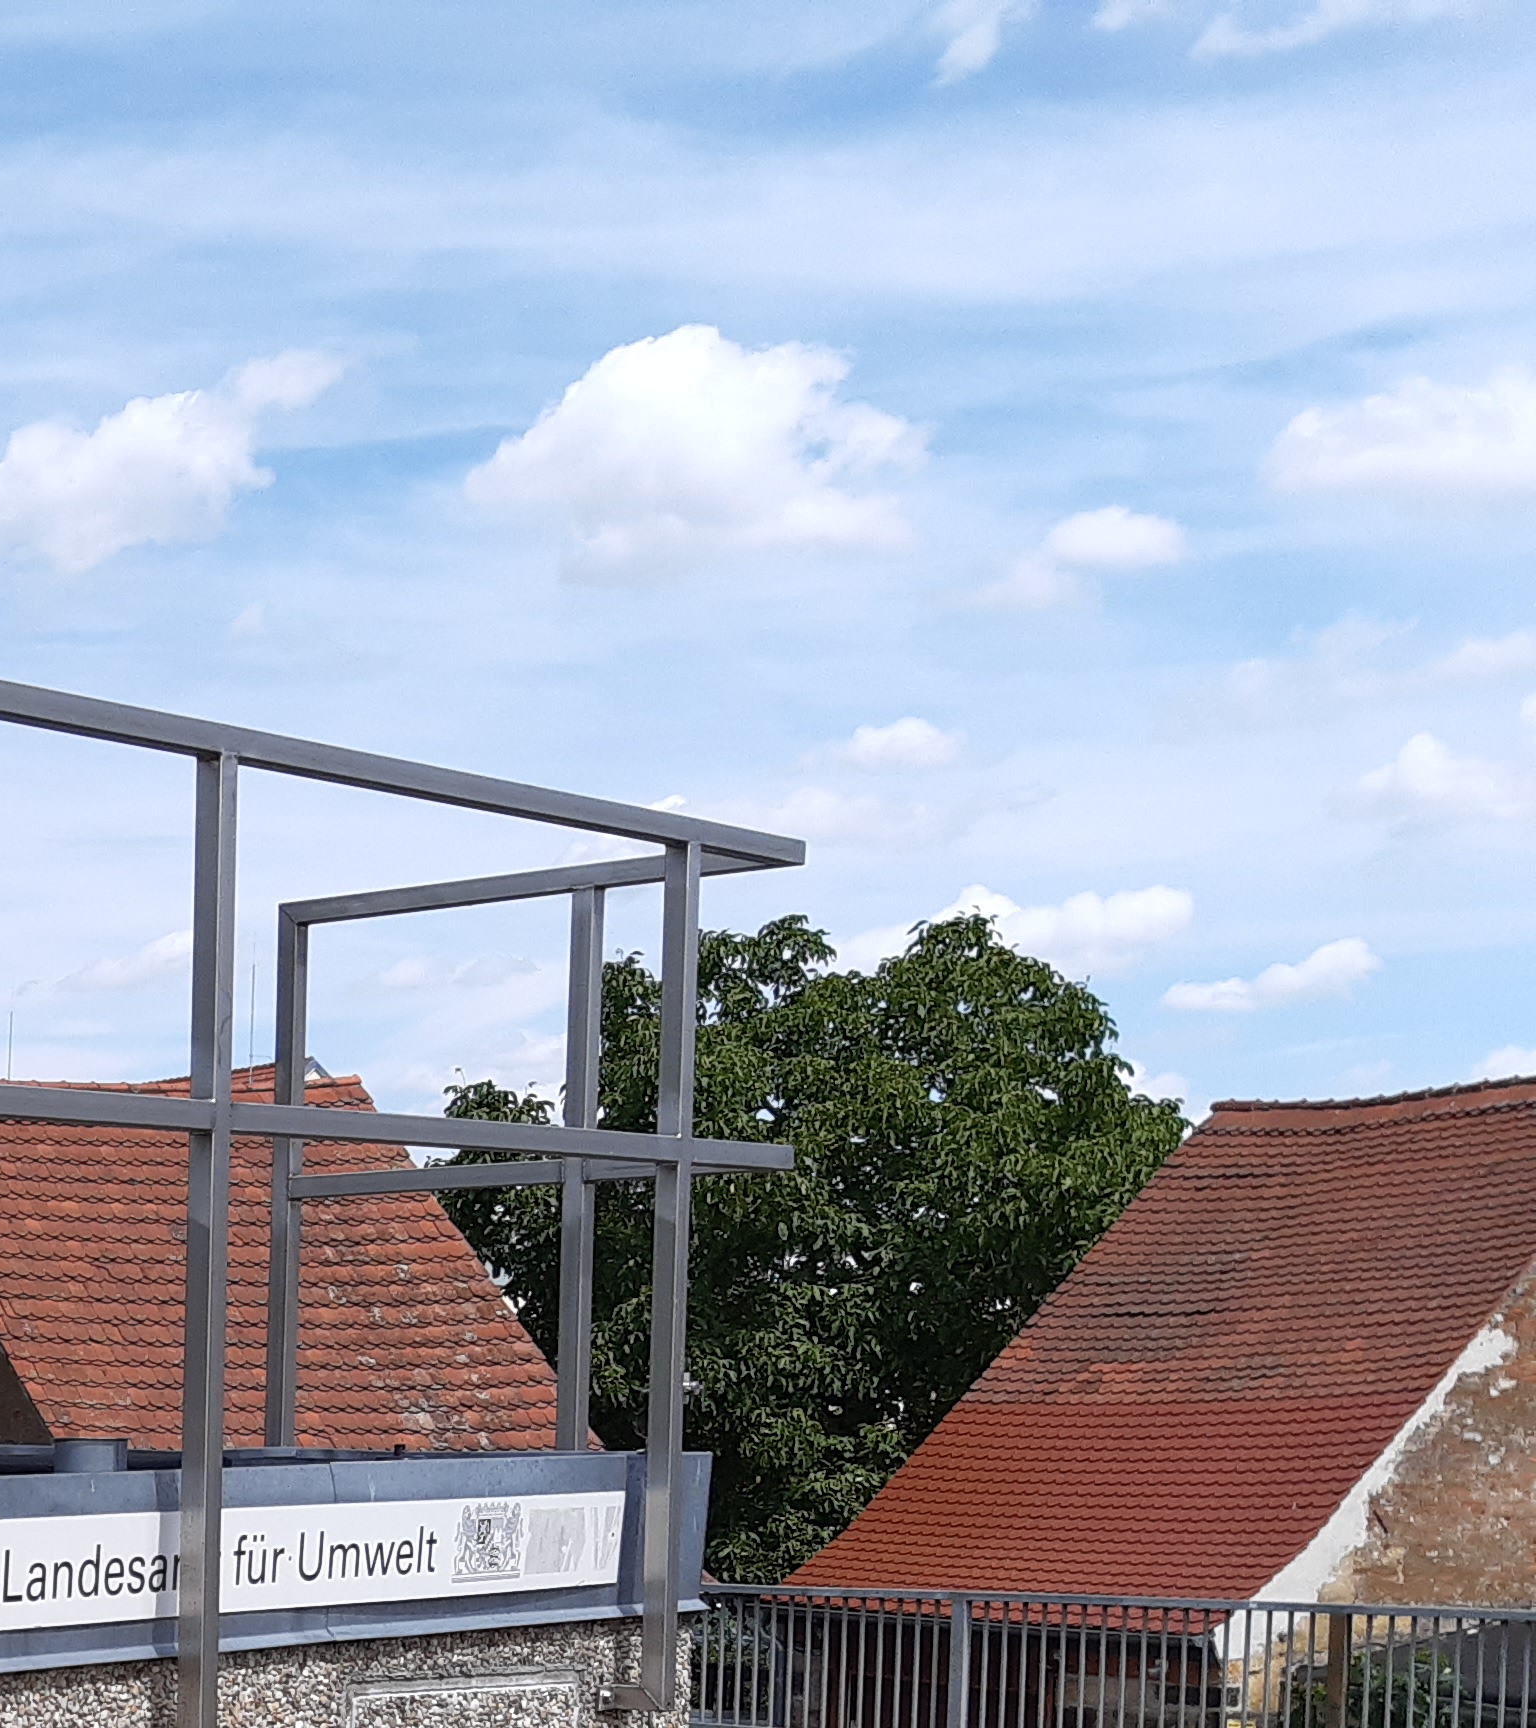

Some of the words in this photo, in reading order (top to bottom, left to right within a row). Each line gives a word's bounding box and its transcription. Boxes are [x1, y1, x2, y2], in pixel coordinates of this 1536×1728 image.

[2, 1543, 180, 1604] Landesa
[233, 1533, 285, 1587] für
[298, 1525, 438, 1582] Umwelt
